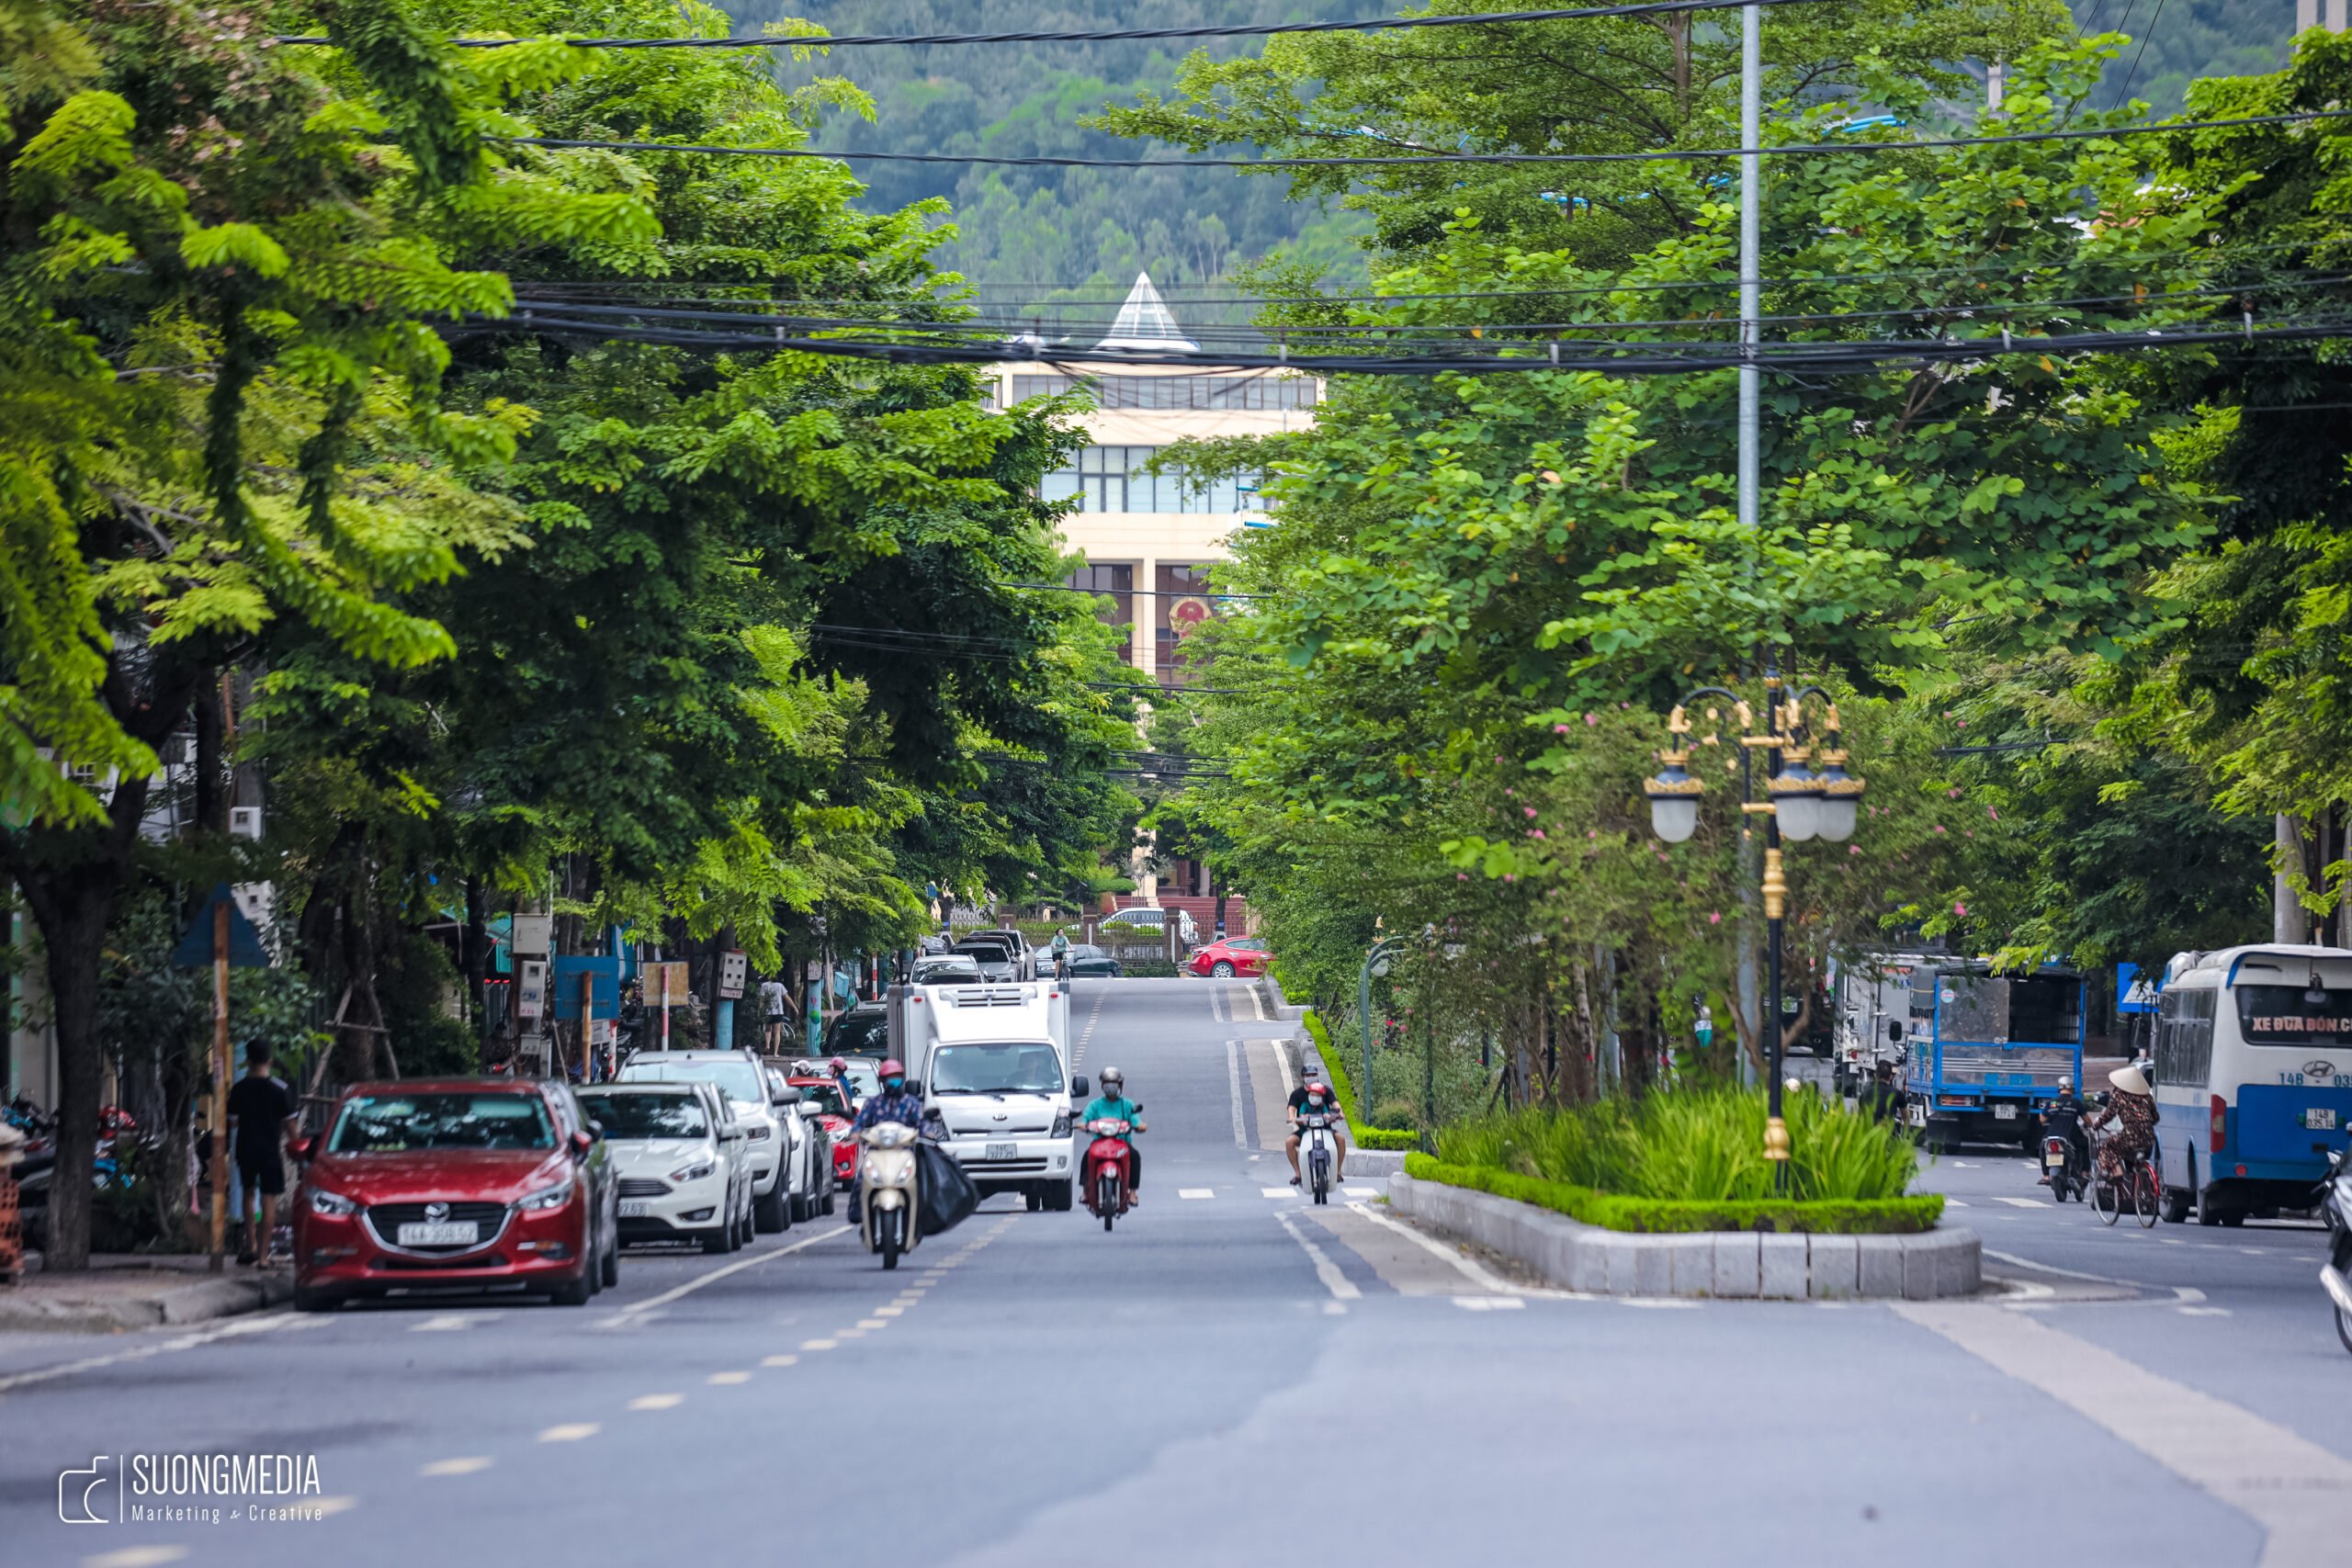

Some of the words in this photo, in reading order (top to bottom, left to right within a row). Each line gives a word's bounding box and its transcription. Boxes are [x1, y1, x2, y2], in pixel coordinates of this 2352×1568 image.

[2253, 1017, 2271, 1032] XE
[2339, 1018, 2352, 1032] C
[2279, 1072, 2304, 1087] 14B
